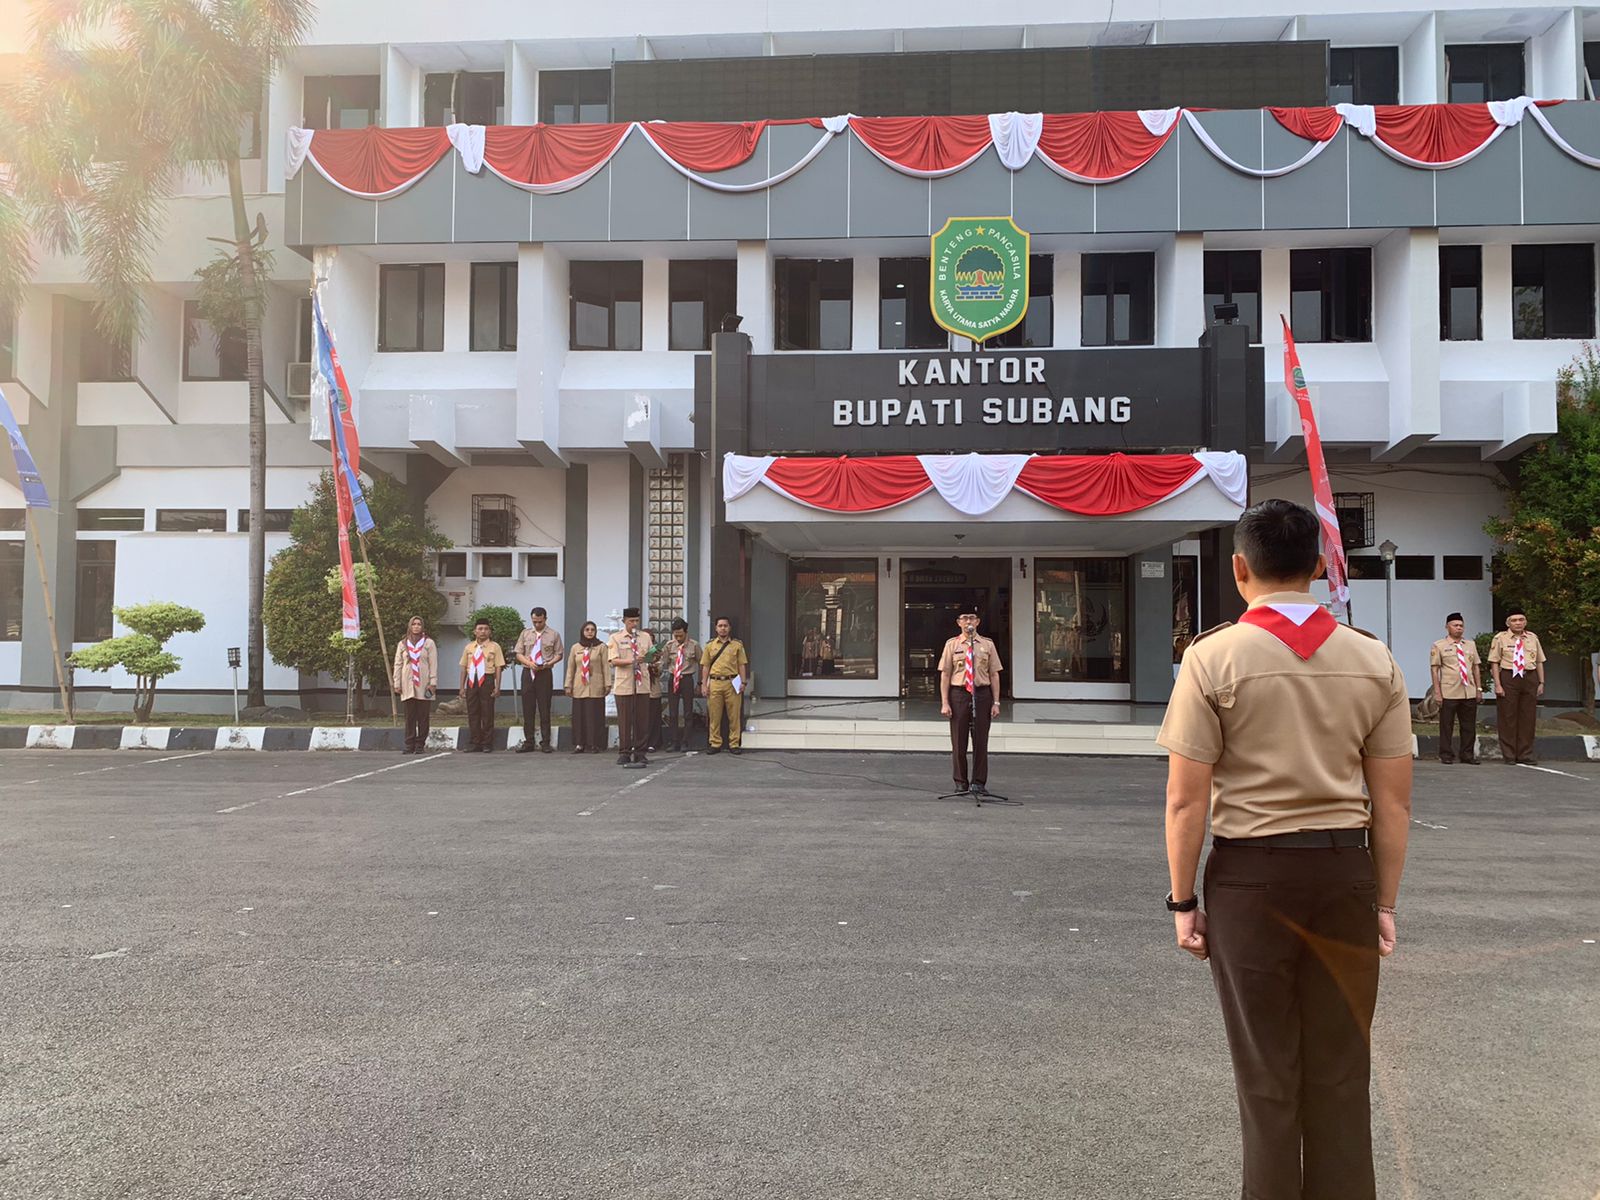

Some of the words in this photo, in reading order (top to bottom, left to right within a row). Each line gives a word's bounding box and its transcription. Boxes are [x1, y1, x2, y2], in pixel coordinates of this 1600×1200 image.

[938, 228, 973, 281] BENTENG
[988, 228, 1021, 280] PANCASILA
[939, 289, 955, 314] KARYA
[952, 311, 977, 329] UTAMA
[977, 315, 1001, 329] SATYA
[999, 288, 1020, 318] NAGARA
[898, 357, 1046, 386] KANTOR
[832, 398, 964, 426] BUPATI
[982, 396, 1132, 424] SUBANG
